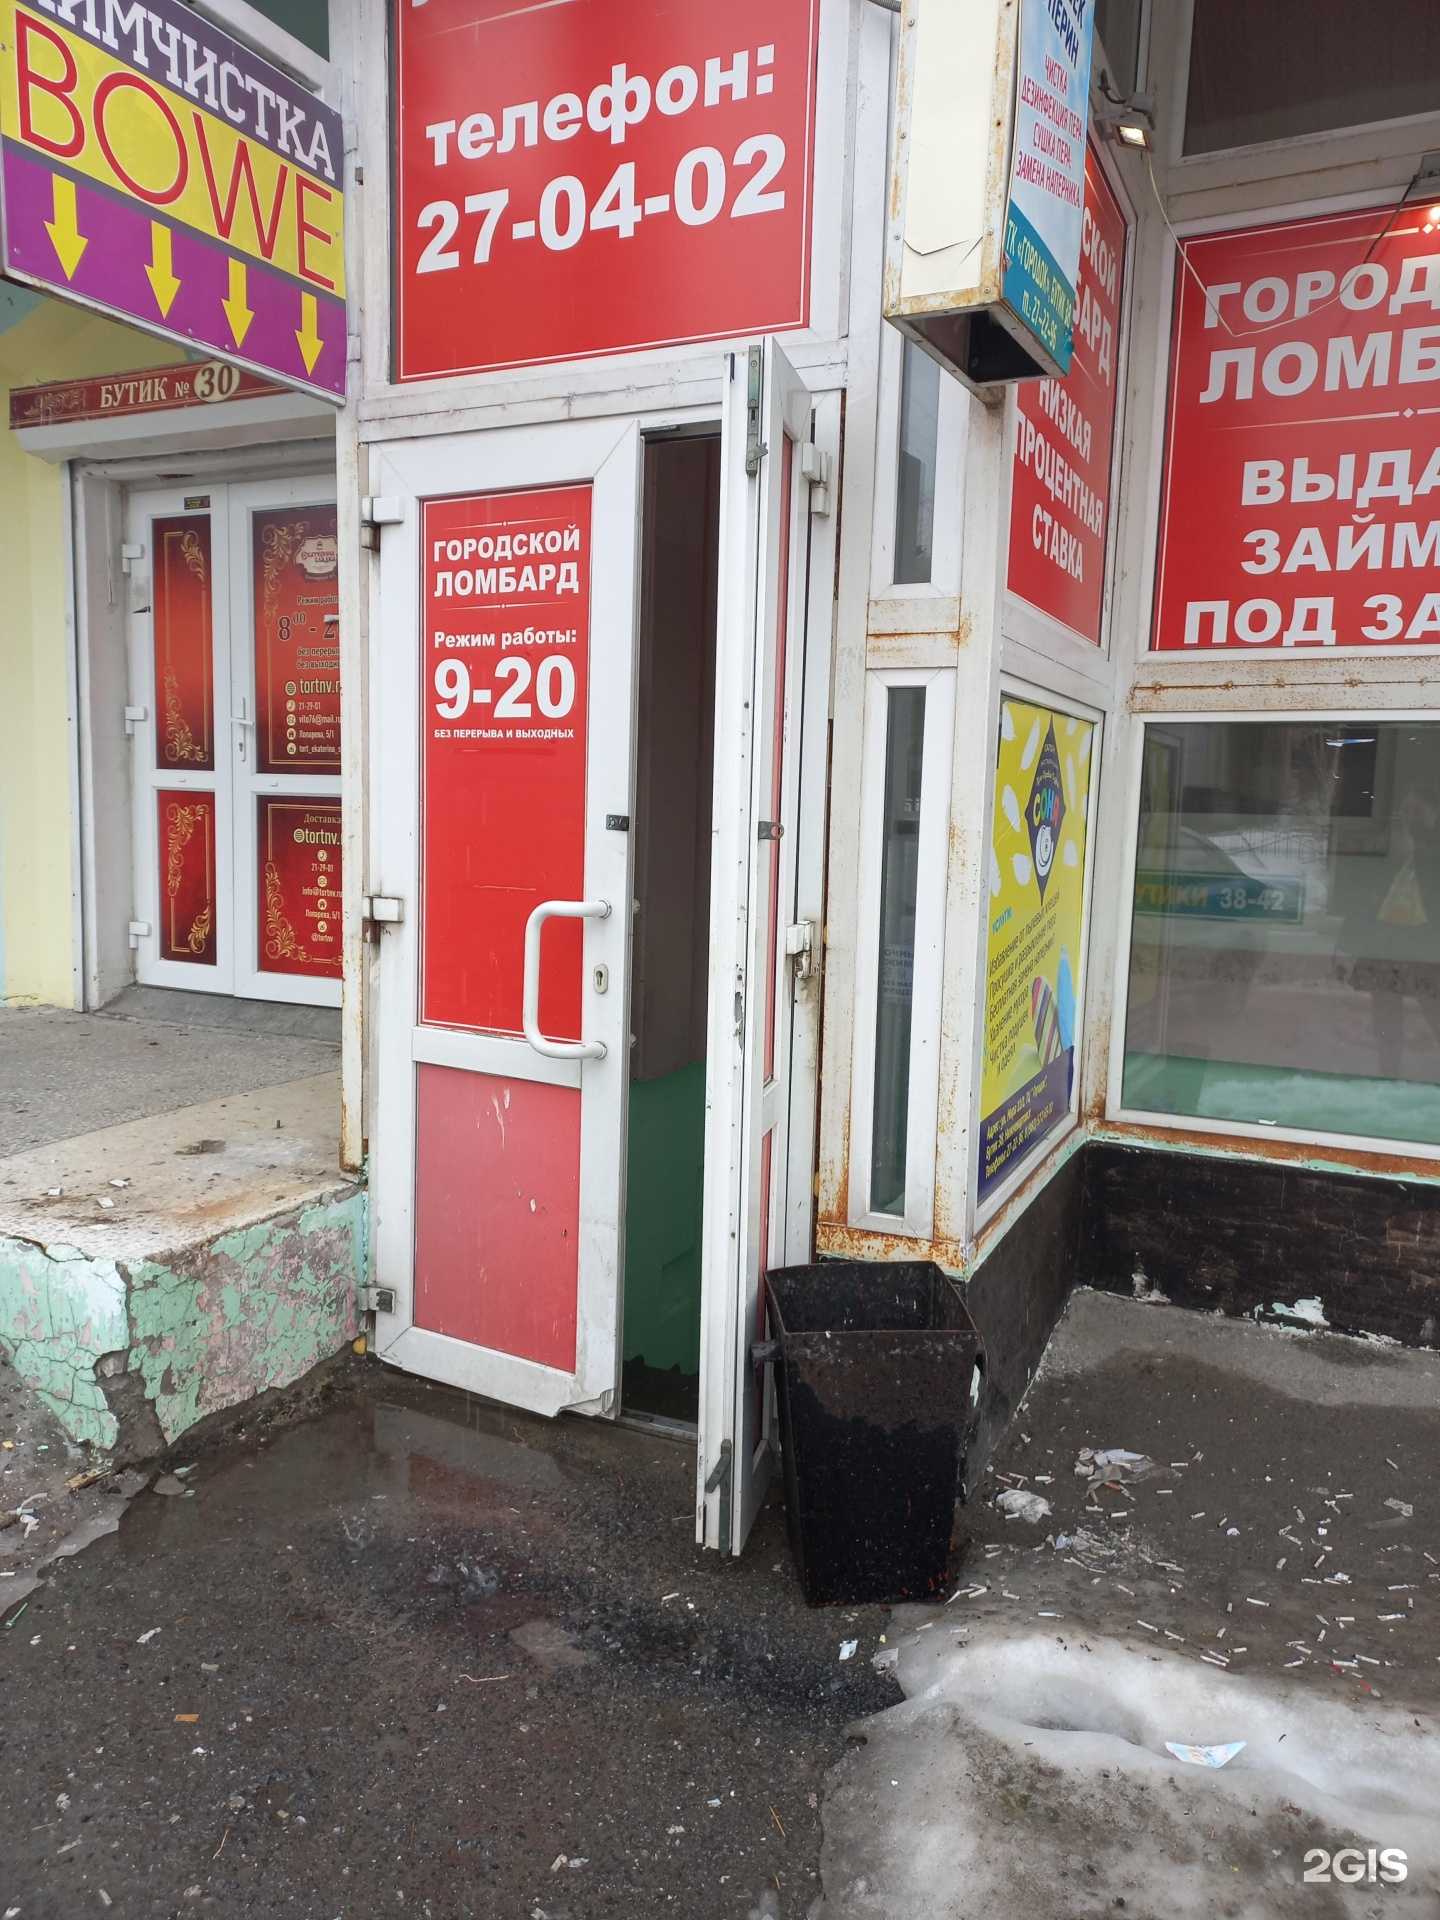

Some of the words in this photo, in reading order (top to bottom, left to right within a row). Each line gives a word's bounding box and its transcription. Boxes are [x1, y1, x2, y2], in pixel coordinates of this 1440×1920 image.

[37, 0, 336, 181] ИМЧИСТКА
[1045, 55, 1067, 96] ЧИСТКА
[426, 43, 775, 166] телефон:
[15, 9, 335, 291] BOWE
[1033, 122, 1055, 158] СУШКА
[1016, 150, 1045, 188] ЗАМЕНА
[416, 133, 786, 274] 27-04-02
[100, 377, 168, 408] БУТИК
[201, 364, 233, 398] 30
[1039, 379, 1092, 464] НИЗКАЯ
[1016, 407, 1104, 539] ПРОЦЕНТНАЯ
[433, 523, 581, 562] ГОРОДСКОЙ
[1032, 503, 1083, 583] СТАВКА
[434, 562, 580, 597] ЛОМБАРД
[434, 631, 495, 649] Режим
[501, 627, 577, 650] работы:
[1184, 596, 1337, 647] ПОД
[434, 654, 576, 719] 9-20
[434, 729, 451, 739] БЕЗ
[453, 728, 504, 739] ПЕРЕРЫВА
[506, 728, 513, 738] И
[515, 728, 574, 739] ВЫХОДНЫХ
[1220, 887, 1284, 911] 38-42
